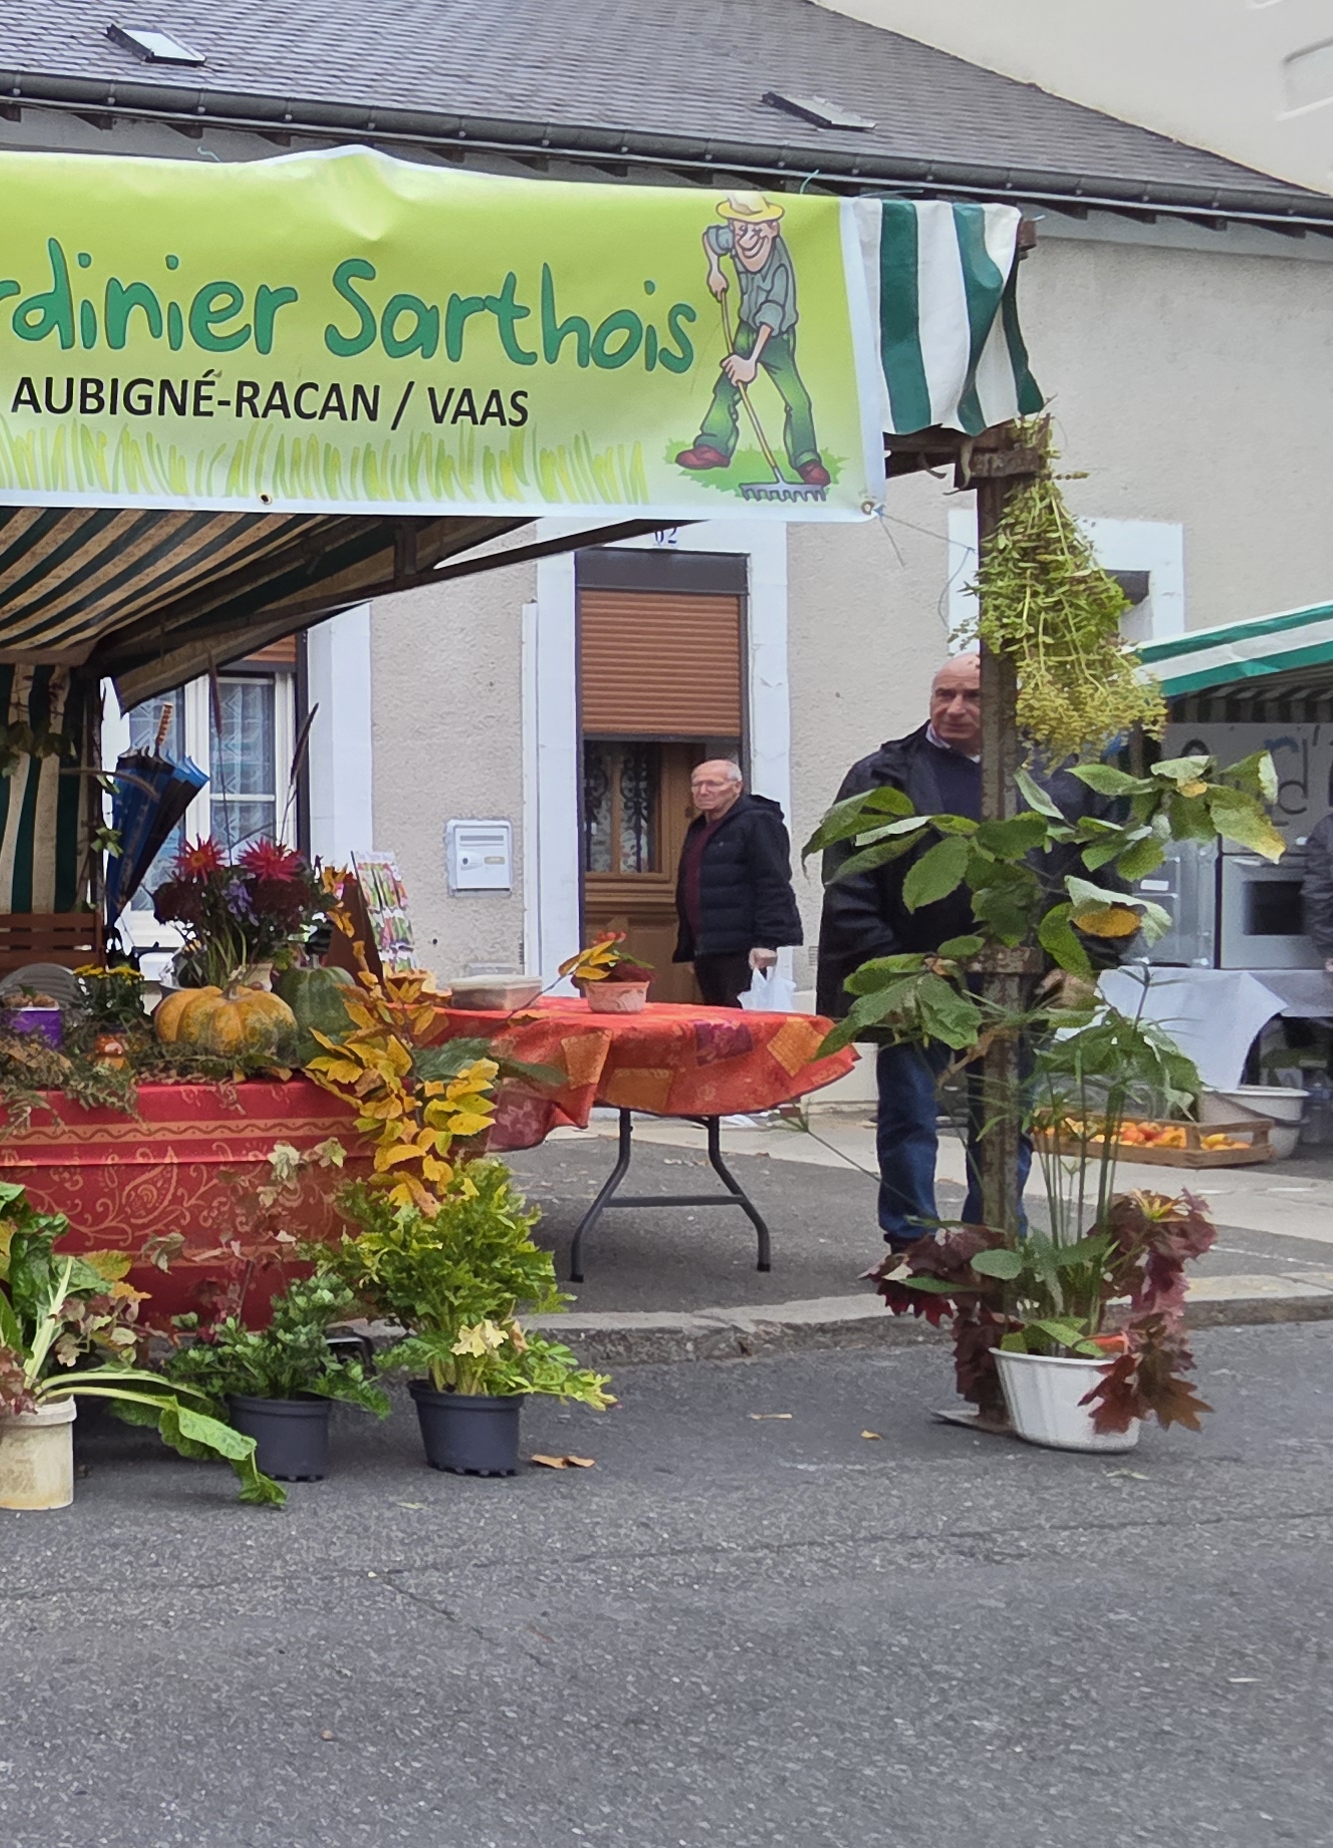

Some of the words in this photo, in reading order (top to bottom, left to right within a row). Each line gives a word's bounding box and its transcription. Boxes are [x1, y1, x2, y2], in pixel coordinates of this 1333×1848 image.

[325, 258, 696, 374] Sarthois
[10, 369, 380, 422] AUBIGNÉ-RACAN
[391, 381, 415, 430] /
[428, 387, 528, 427] VAAS
